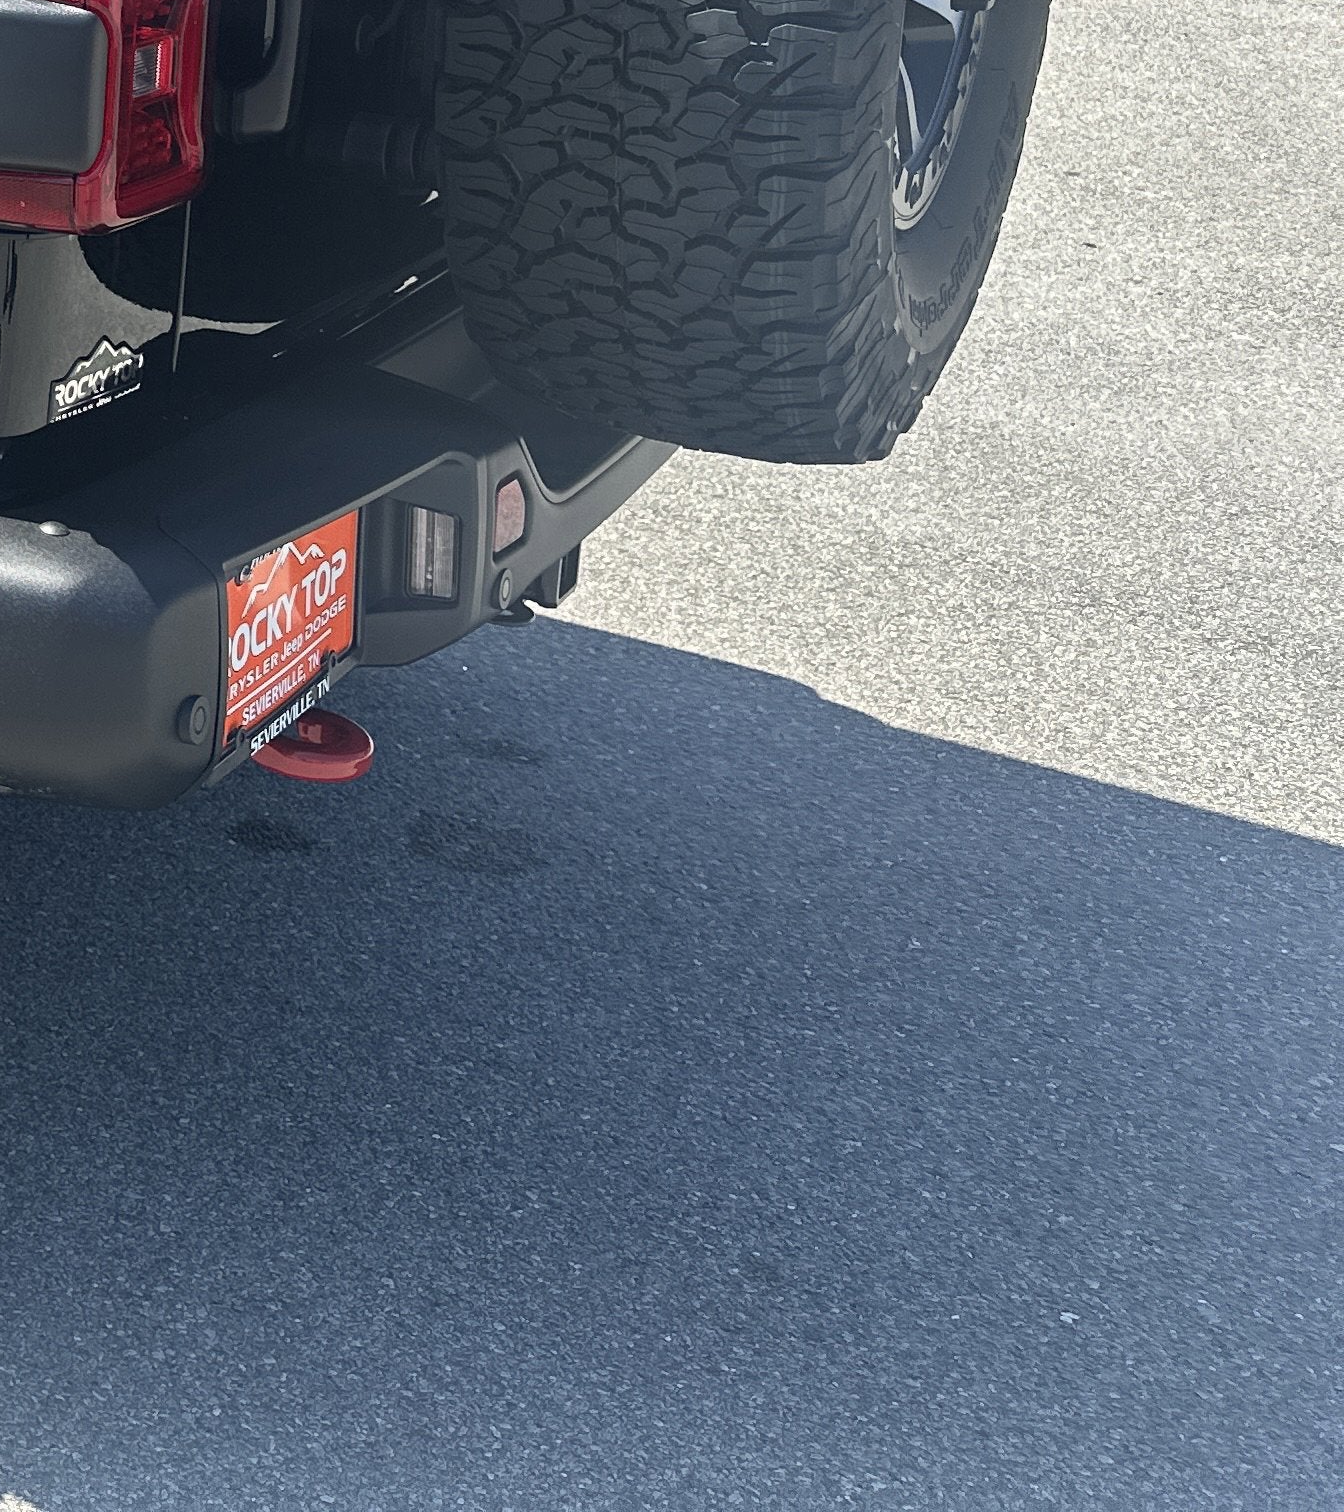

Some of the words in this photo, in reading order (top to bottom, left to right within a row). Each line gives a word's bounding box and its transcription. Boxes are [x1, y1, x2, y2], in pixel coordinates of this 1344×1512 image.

[55, 367, 111, 406] ROCKY
[228, 584, 299, 678] OCKY
[302, 548, 347, 617] TOP
[280, 633, 303, 662] Jeep
[305, 594, 347, 640] DODGE
[242, 663, 306, 726] SEVIERVILLE,
[308, 649, 322, 672] TN
[250, 690, 316, 757] SEVIERVILLE,
[317, 675, 330, 699] TN
